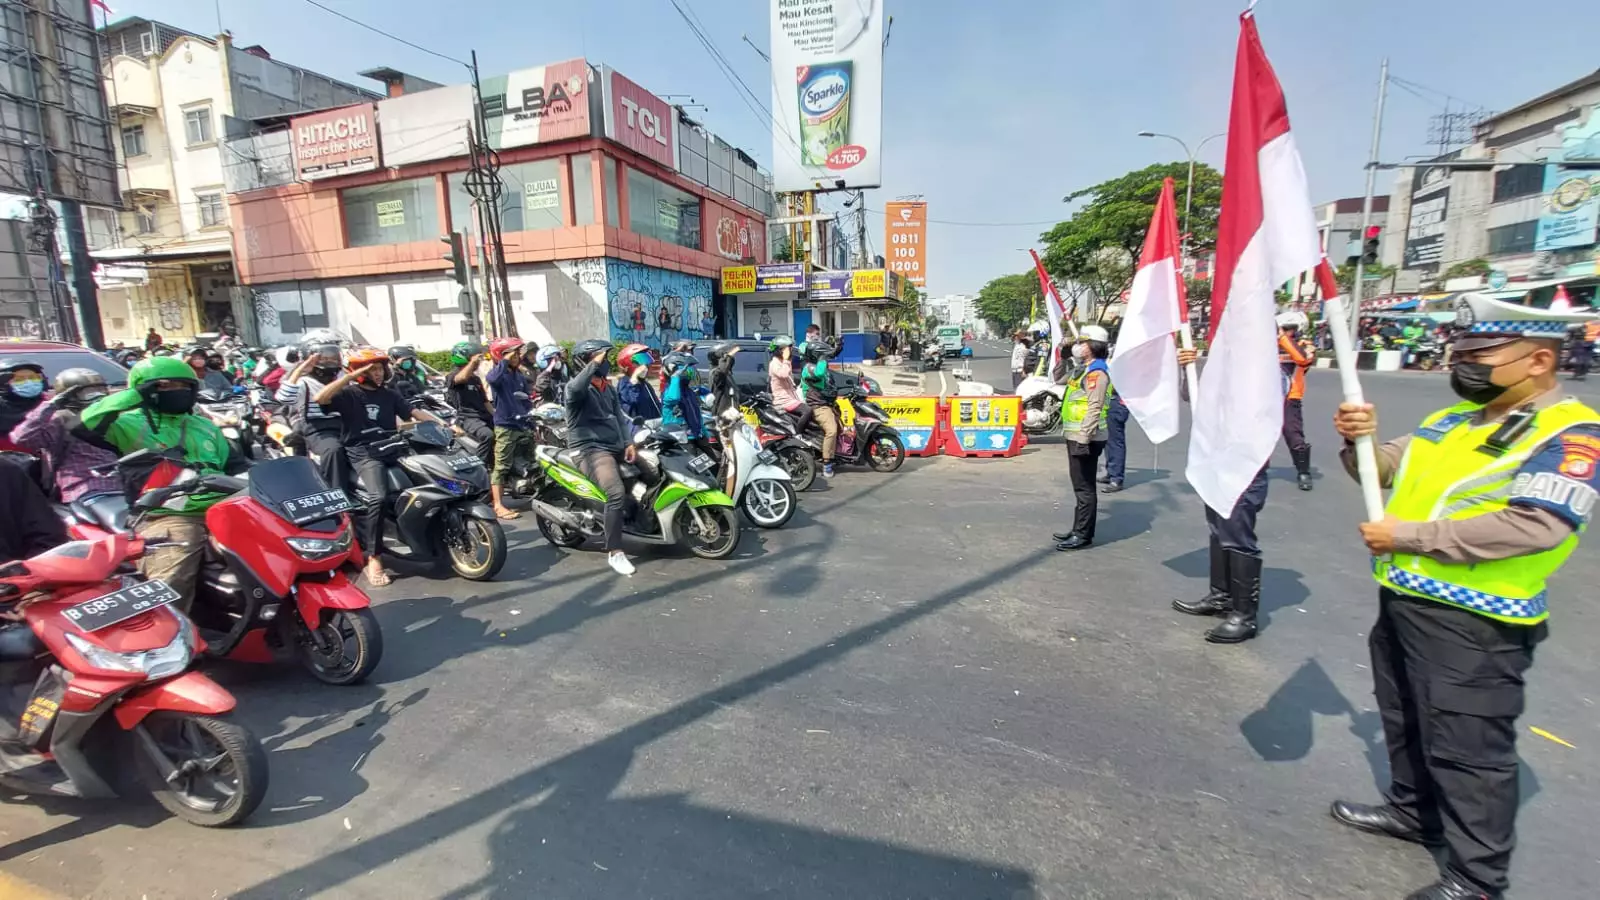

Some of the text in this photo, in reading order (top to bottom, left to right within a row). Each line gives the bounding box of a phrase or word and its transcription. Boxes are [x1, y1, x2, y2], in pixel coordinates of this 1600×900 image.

[780, 5, 833, 20] Mau Kesat
[782, 22, 797, 30] Mau
[810, 35, 834, 44] Wangi
[807, 82, 844, 104] Sparkle
[482, 83, 571, 119] ELBA
[621, 96, 667, 145] TCL
[298, 114, 367, 146] HITACHI
[297, 135, 372, 160] Inspire the Next
[527, 181, 556, 193] DIJUAL
[892, 233, 919, 244] 0811
[894, 247, 916, 258] 100
[891, 261, 919, 272] 1200
[723, 269, 753, 280] TOLAK
[855, 275, 883, 284] TOLAK
[725, 280, 753, 289] ANGIN
[856, 284, 884, 292] ANGIN
[287, 502, 297, 512] B
[297, 495, 325, 508] 5629
[66, 580, 166, 621] B 6851 EWJ
